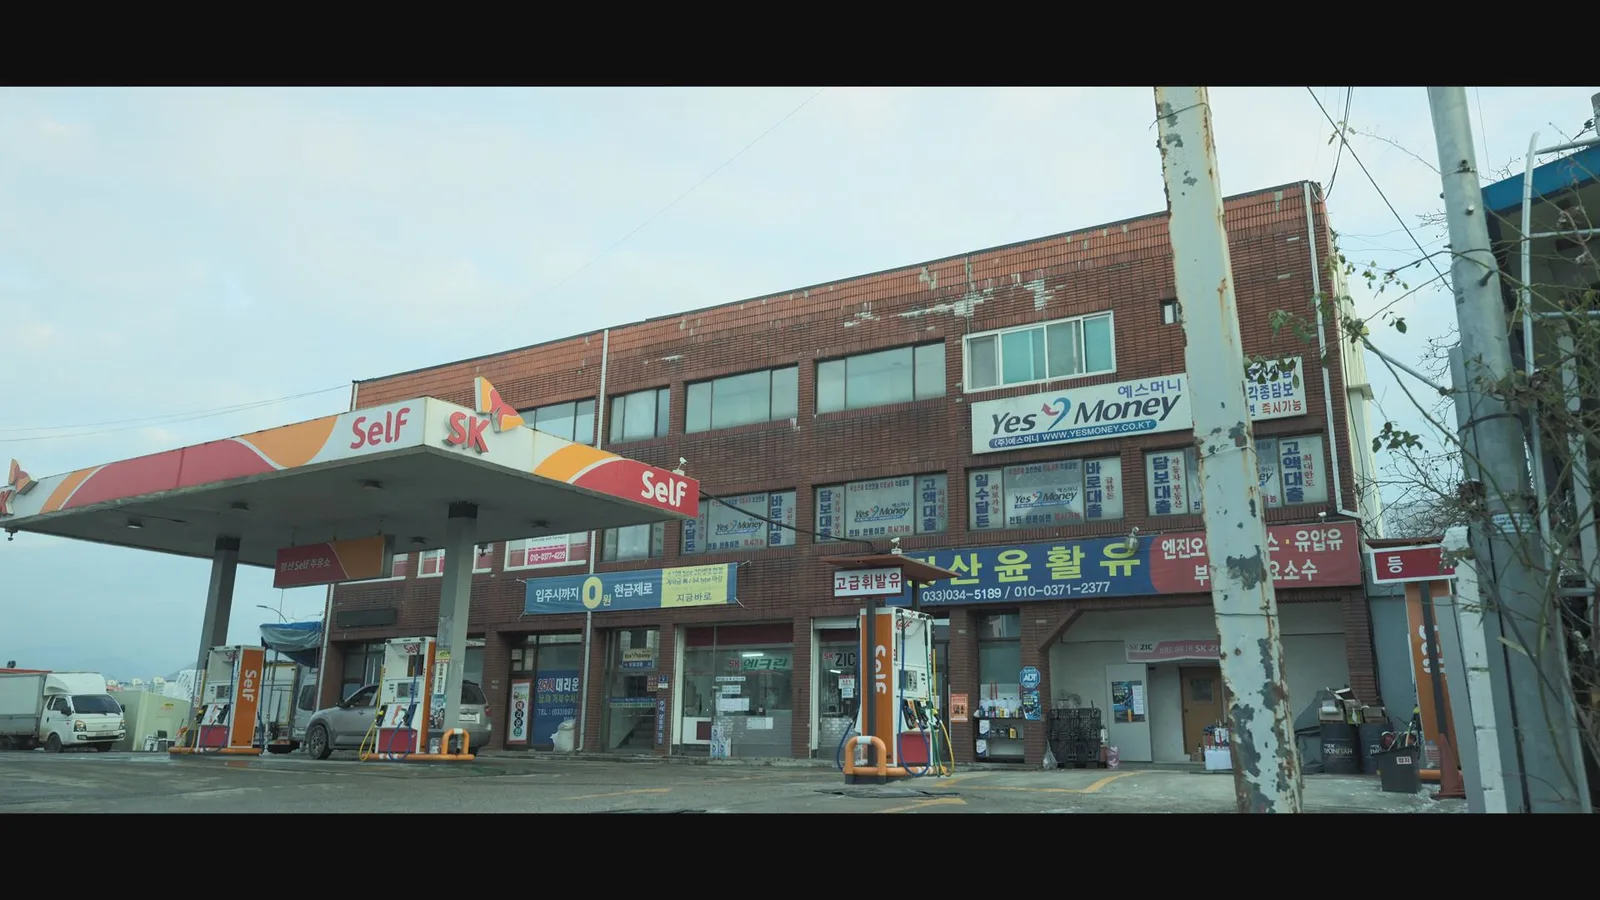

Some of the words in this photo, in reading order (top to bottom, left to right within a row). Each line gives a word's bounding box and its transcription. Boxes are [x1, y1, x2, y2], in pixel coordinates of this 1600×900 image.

[1118, 379, 1181, 398] 예스머니
[1248, 382, 1293, 401] 각종담보
[992, 412, 1037, 435] Yes
[1074, 395, 1181, 424] Money
[1262, 400, 1302, 414] 즉시가능
[350, 407, 410, 450] Self
[446, 411, 490, 453] SK
[994, 435, 1039, 447] (주)예스머니
[1282, 442, 1304, 502] 고액대출
[1304, 454, 1315, 487] 최대한도
[640, 470, 688, 508] Self
[1086, 462, 1102, 518] 바로대출
[1153, 456, 1172, 514] 담보대출
[922, 478, 936, 532] 고액대출
[975, 474, 990, 528] 일수달돈
[1015, 494, 1031, 504] Yes
[1043, 492, 1078, 502] Money
[820, 490, 832, 540] 담보대출
[855, 510, 870, 518] Yes
[880, 507, 910, 516] Money
[716, 522, 728, 532] Yes
[738, 521, 764, 530] Money
[1162, 536, 1206, 560] 엔진오
[1294, 528, 1344, 552] 유압유
[295, 559, 311, 570] Self
[536, 587, 579, 602] 입주시까지
[614, 582, 653, 598] 현금제로
[835, 573, 901, 591] 고급휘발유
[922, 588, 1002, 602] 033)034-5189
[1014, 582, 1110, 598] 010-0371-2377
[676, 592, 712, 602] 지금바로
[728, 659, 740, 668] SK
[742, 657, 788, 670] 엔크린
[835, 652, 856, 667] ZIC
[242, 670, 257, 702] Self
[1023, 674, 1038, 682] ADT
